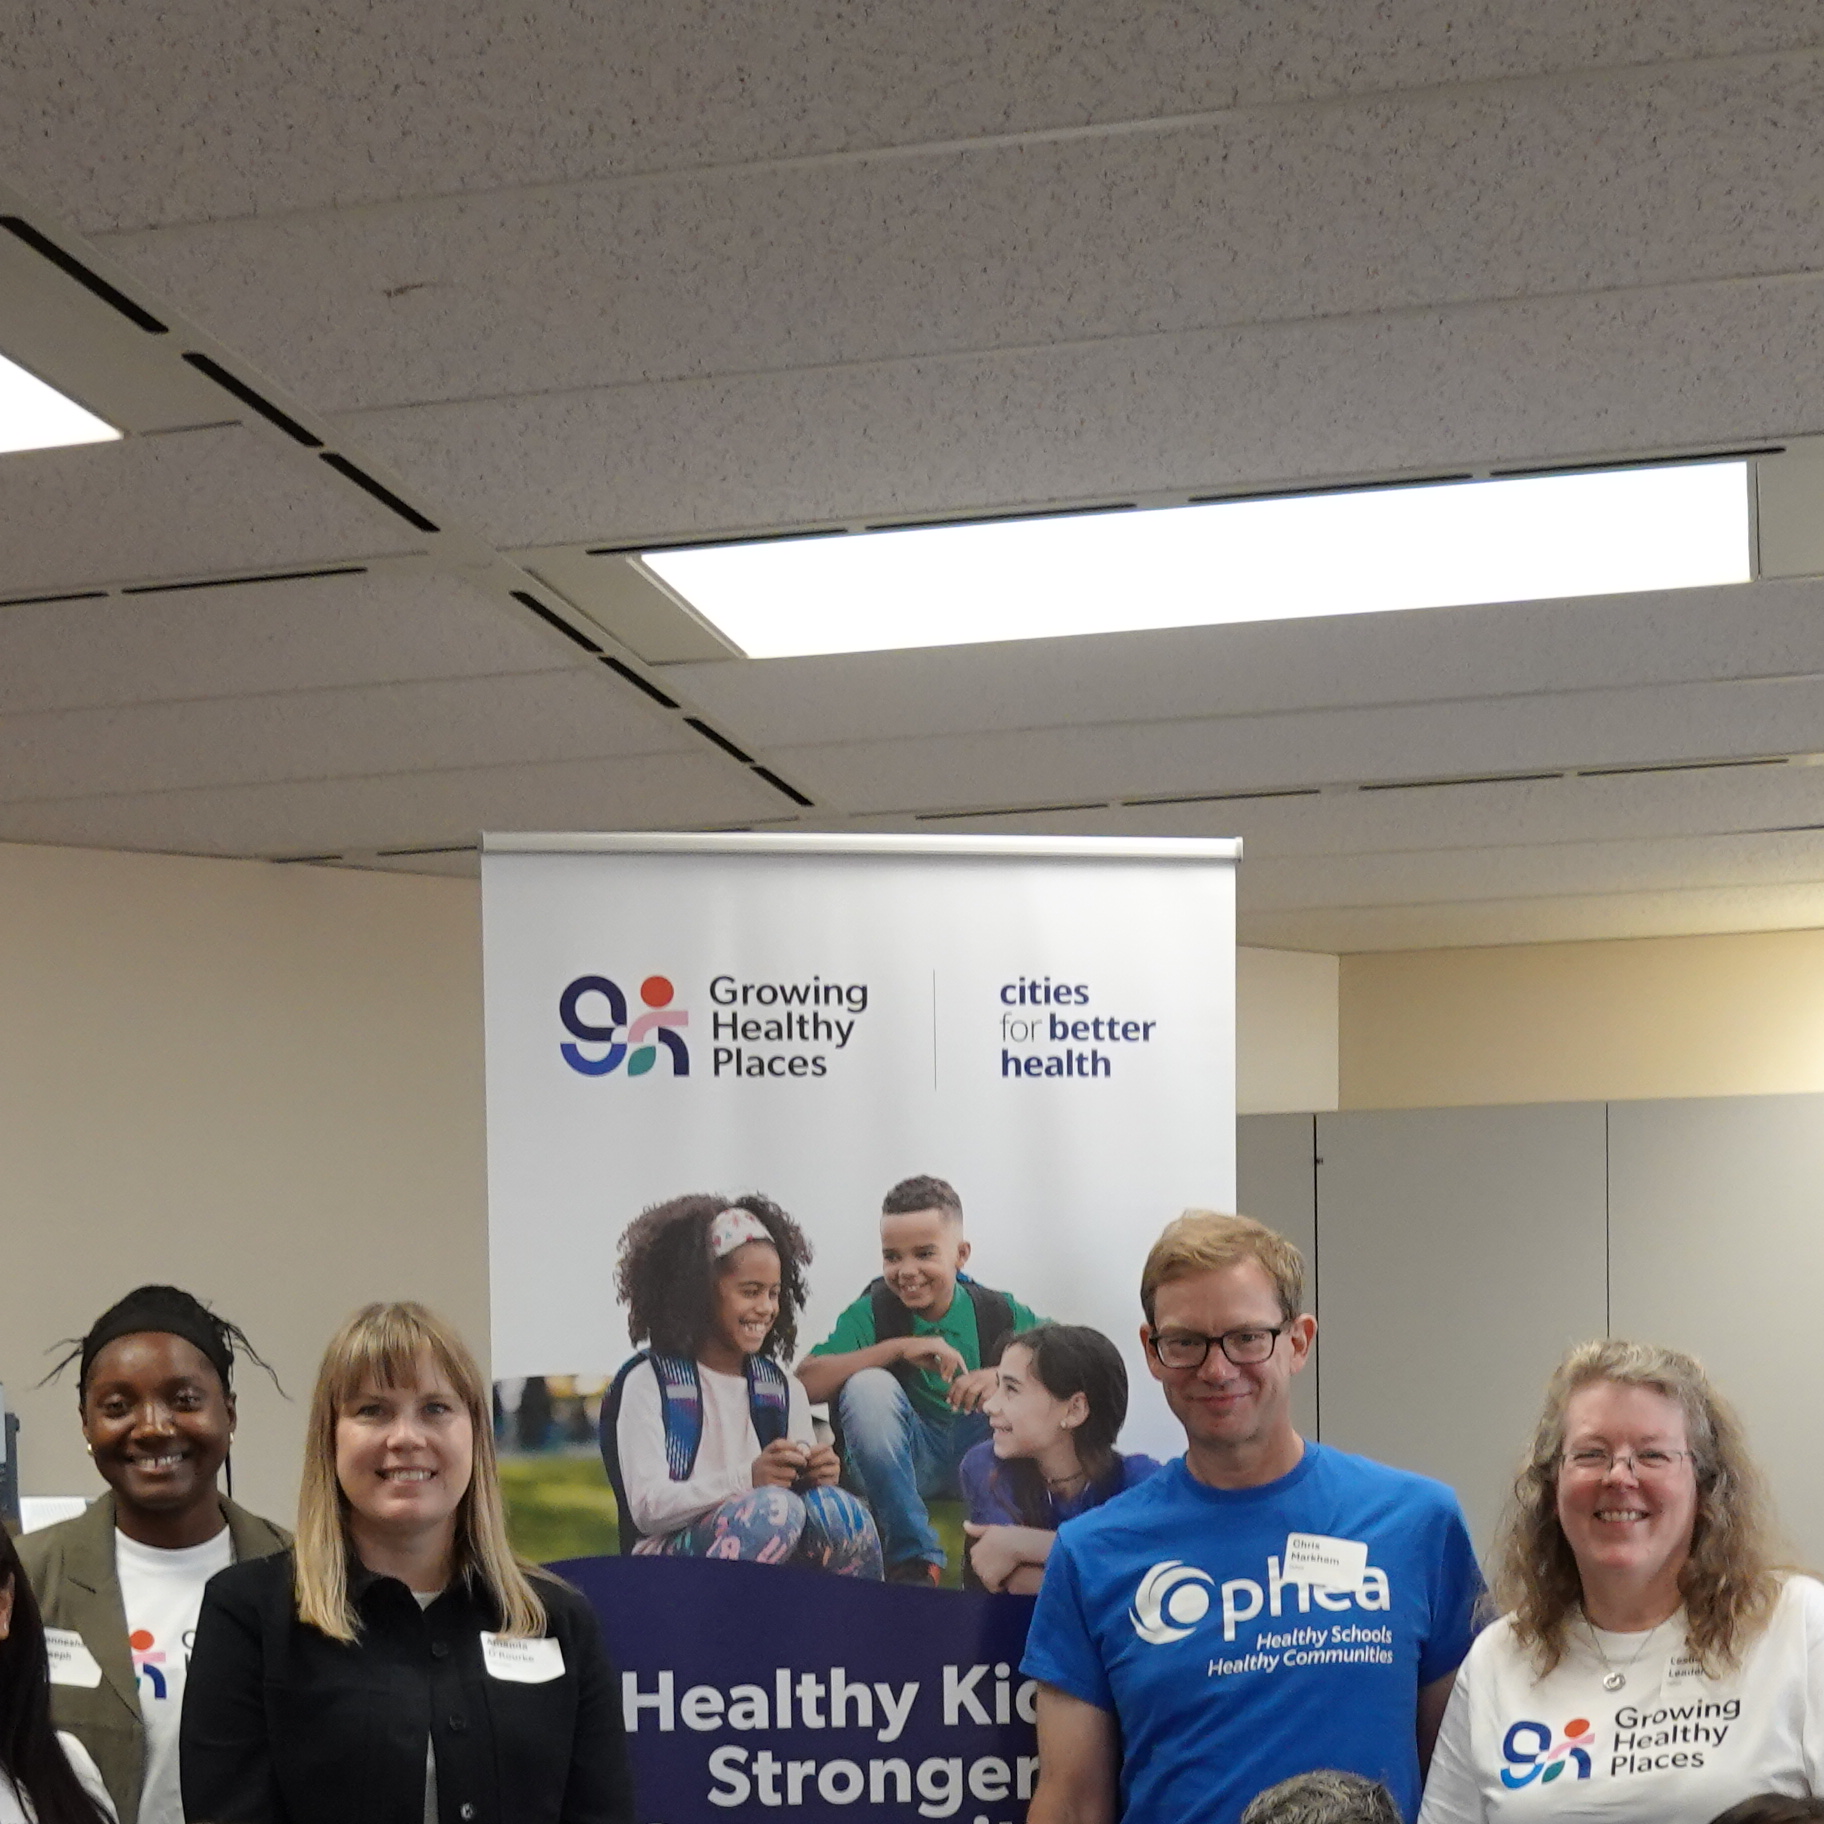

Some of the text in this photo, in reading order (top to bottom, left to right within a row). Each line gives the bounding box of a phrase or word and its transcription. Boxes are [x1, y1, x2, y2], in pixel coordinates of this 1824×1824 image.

[709, 976, 869, 1013] Growing
[999, 977, 1090, 1006] cities
[712, 1011, 855, 1048] Healthy
[1000, 1012, 1157, 1043] for better
[713, 1047, 828, 1078] Places
[1001, 1048, 1112, 1078] health
[1256, 1623, 1393, 1651] Healthy Schools
[1207, 1644, 1394, 1677] Healthy Communities
[621, 1666, 921, 1743] Healthy
[1614, 1697, 1741, 1730] Growing
[1613, 1721, 1730, 1753] Healthy
[1610, 1751, 1705, 1778] Places
[707, 1744, 1040, 1819] Stronger
